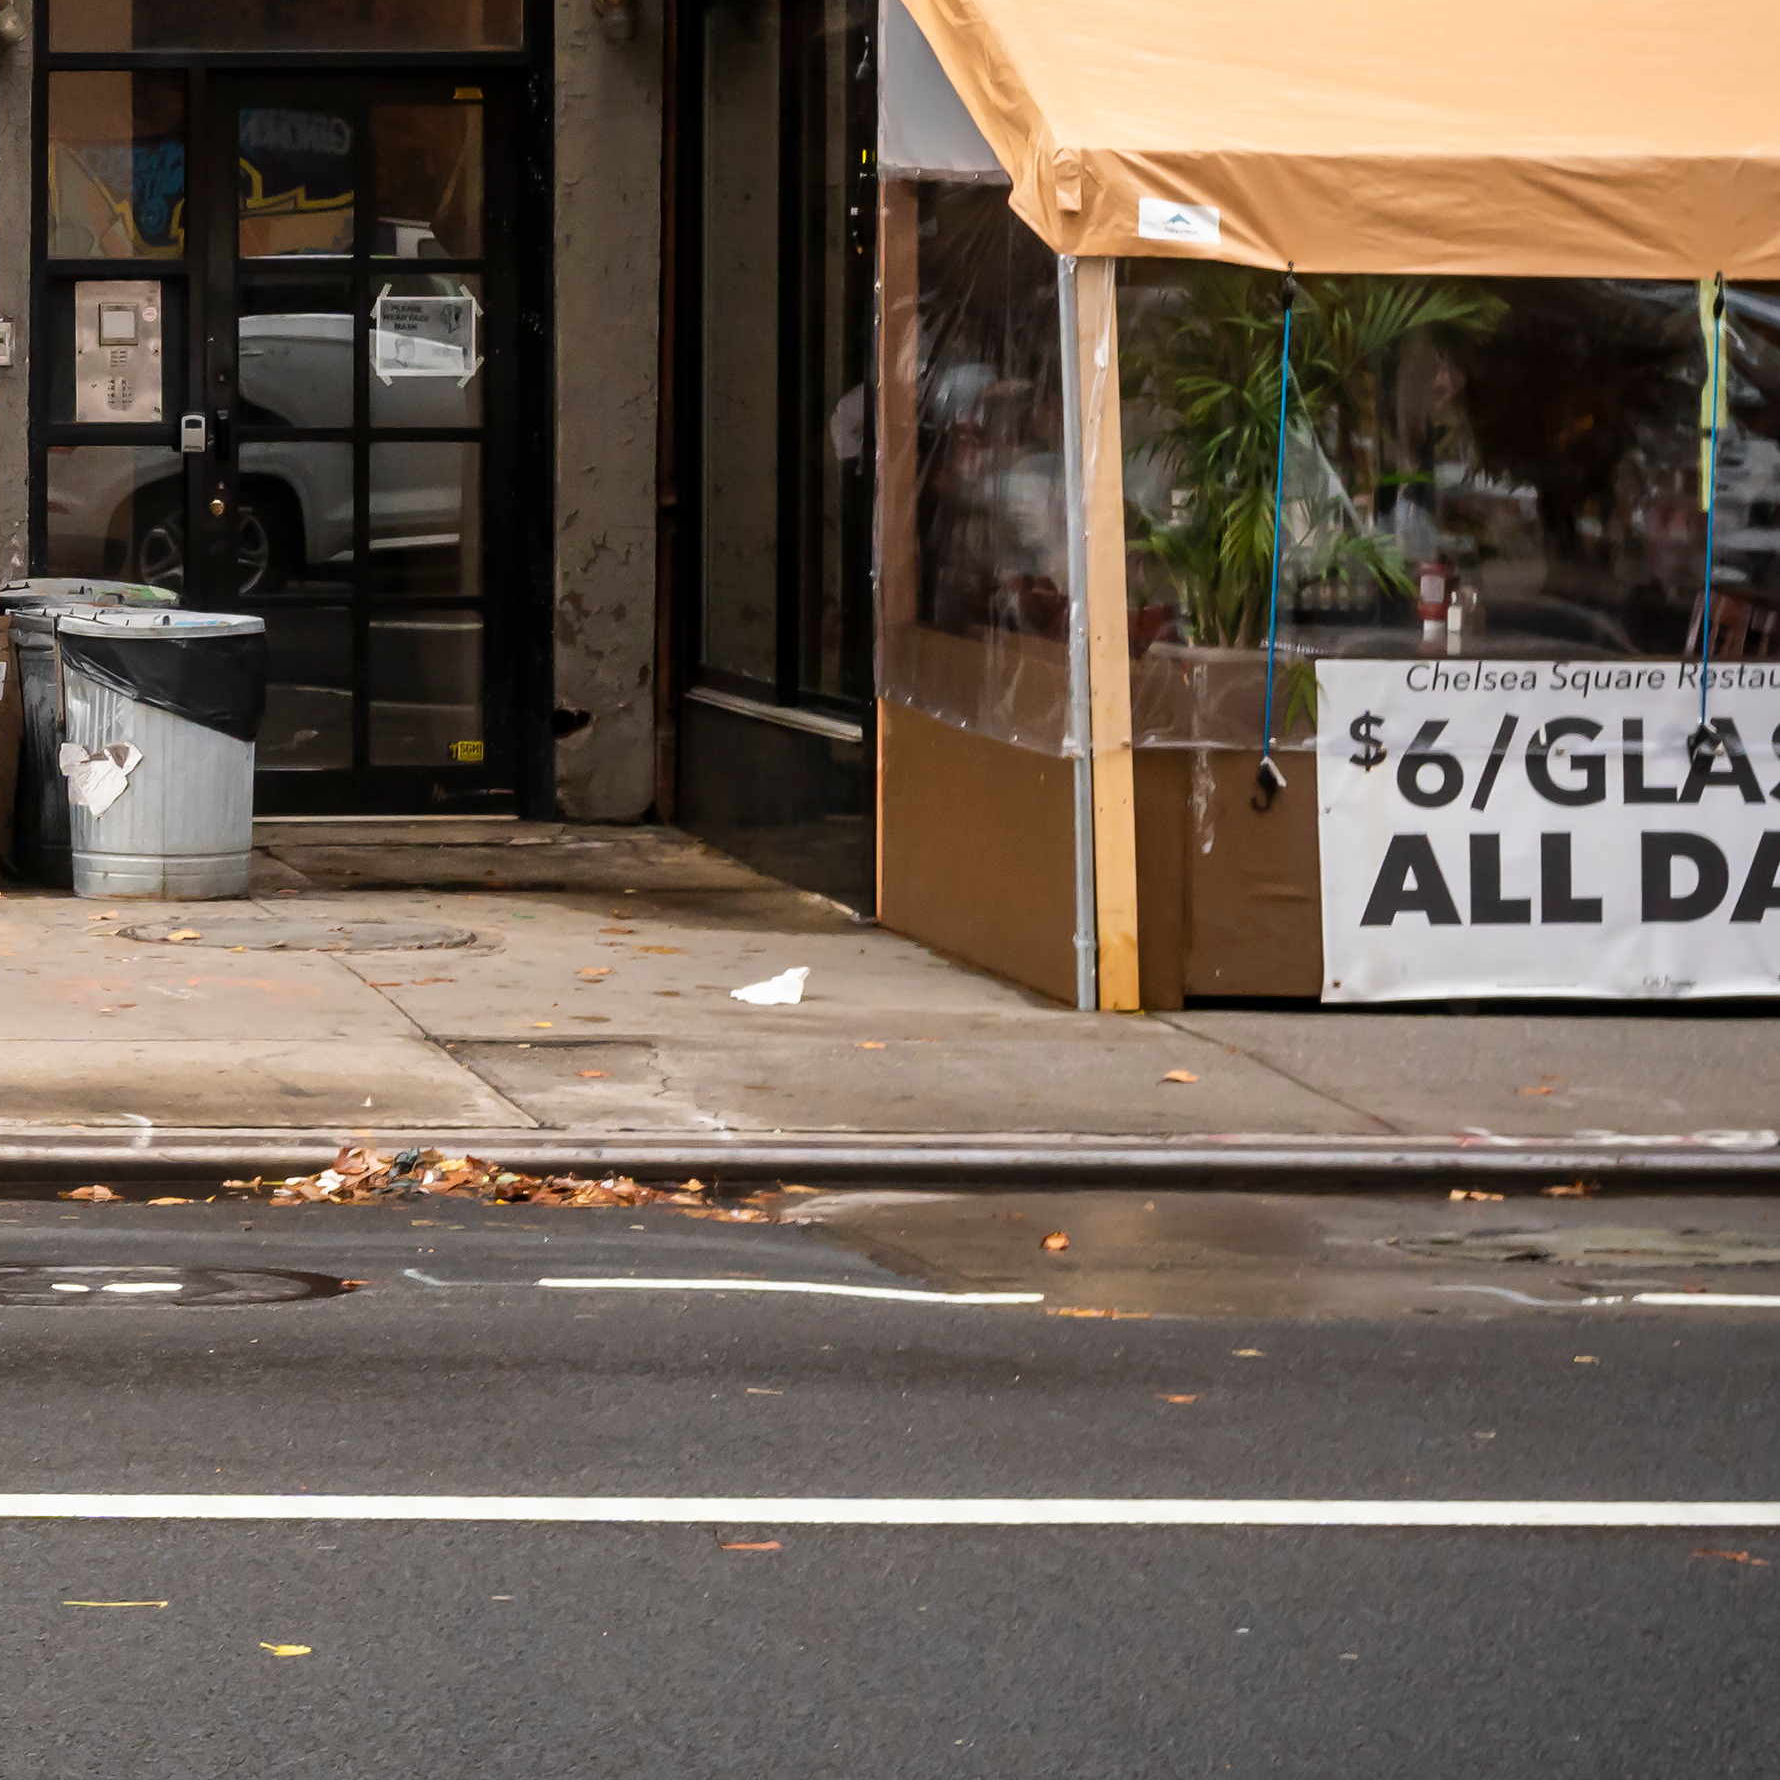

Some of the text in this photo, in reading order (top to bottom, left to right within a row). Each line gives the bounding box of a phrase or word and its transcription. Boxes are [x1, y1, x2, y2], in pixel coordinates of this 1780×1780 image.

[1407, 661, 1538, 694] Chelsea
[1551, 661, 1666, 698] Square
[1349, 710, 1780, 812] $6/GLA
[1360, 831, 1603, 928] ALL
